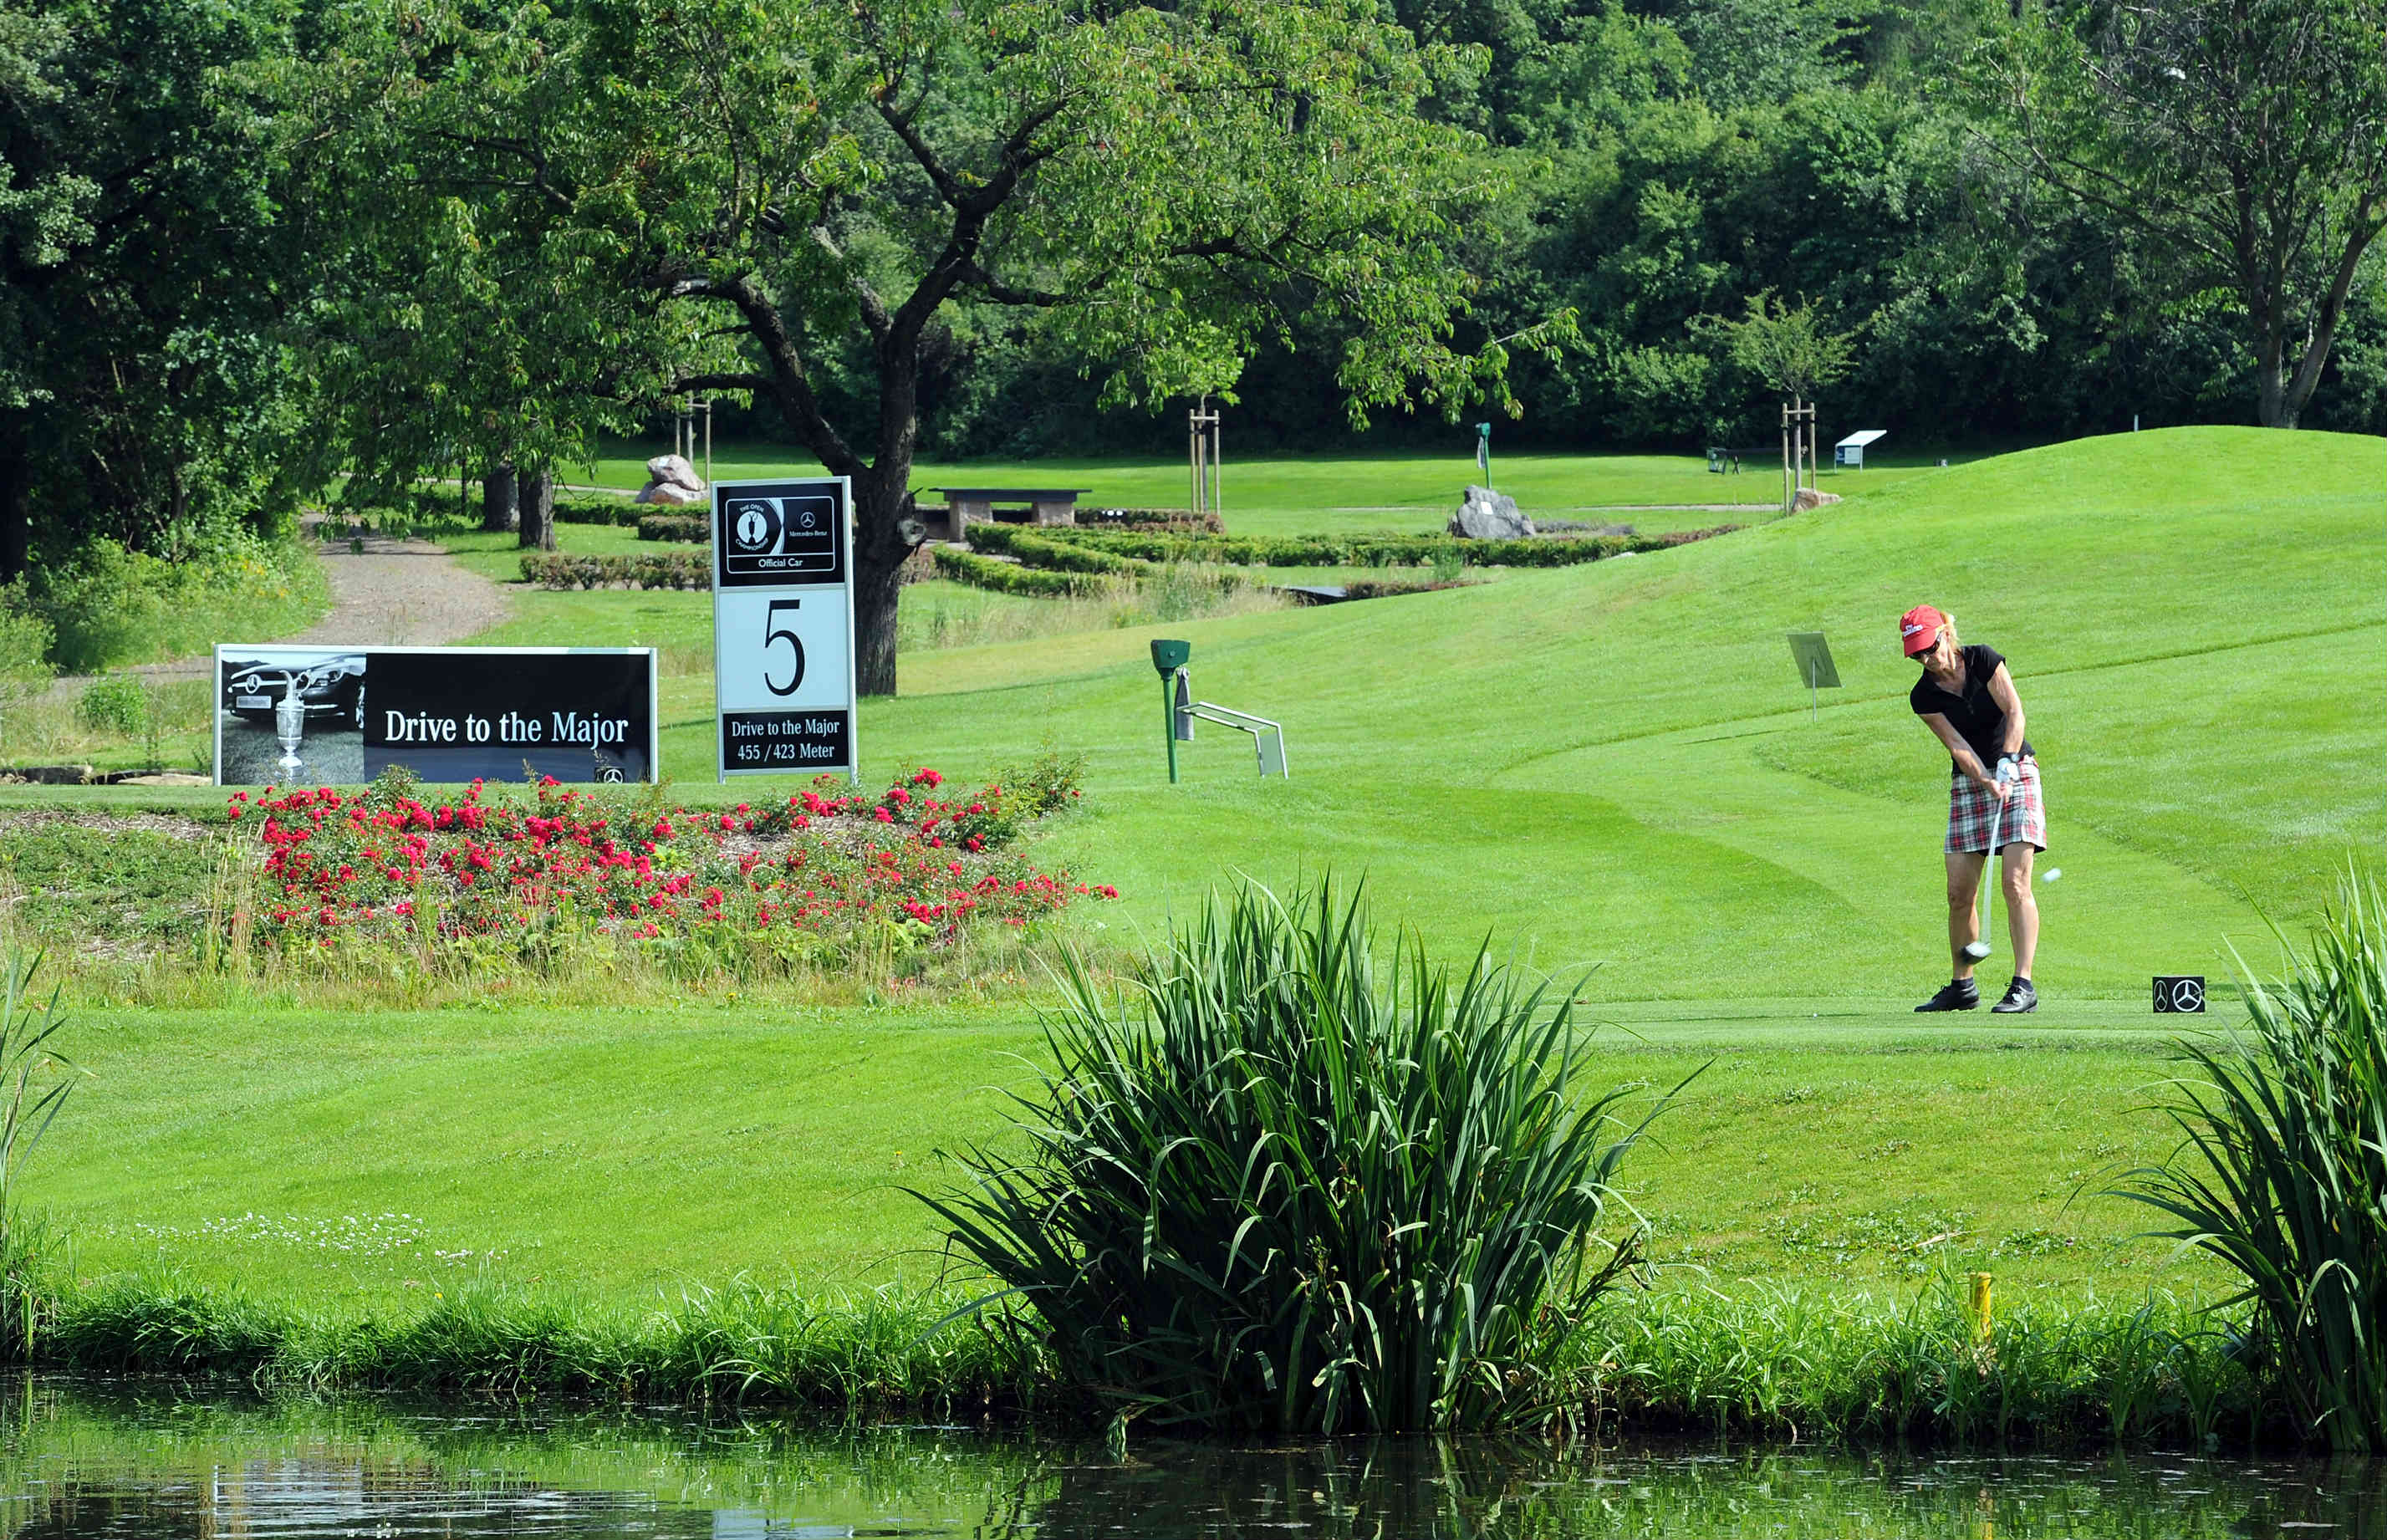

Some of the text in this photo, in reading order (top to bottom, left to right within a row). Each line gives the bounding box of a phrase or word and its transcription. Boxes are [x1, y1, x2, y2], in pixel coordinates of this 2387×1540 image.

[750, 504, 764, 512] OPEN
[757, 558, 803, 569] Official Car
[764, 599, 805, 696] 5
[385, 710, 629, 751] Drive to the Major
[732, 718, 840, 737] Drive to the Major
[737, 744, 761, 760] 455
[799, 742, 835, 758] Meter
